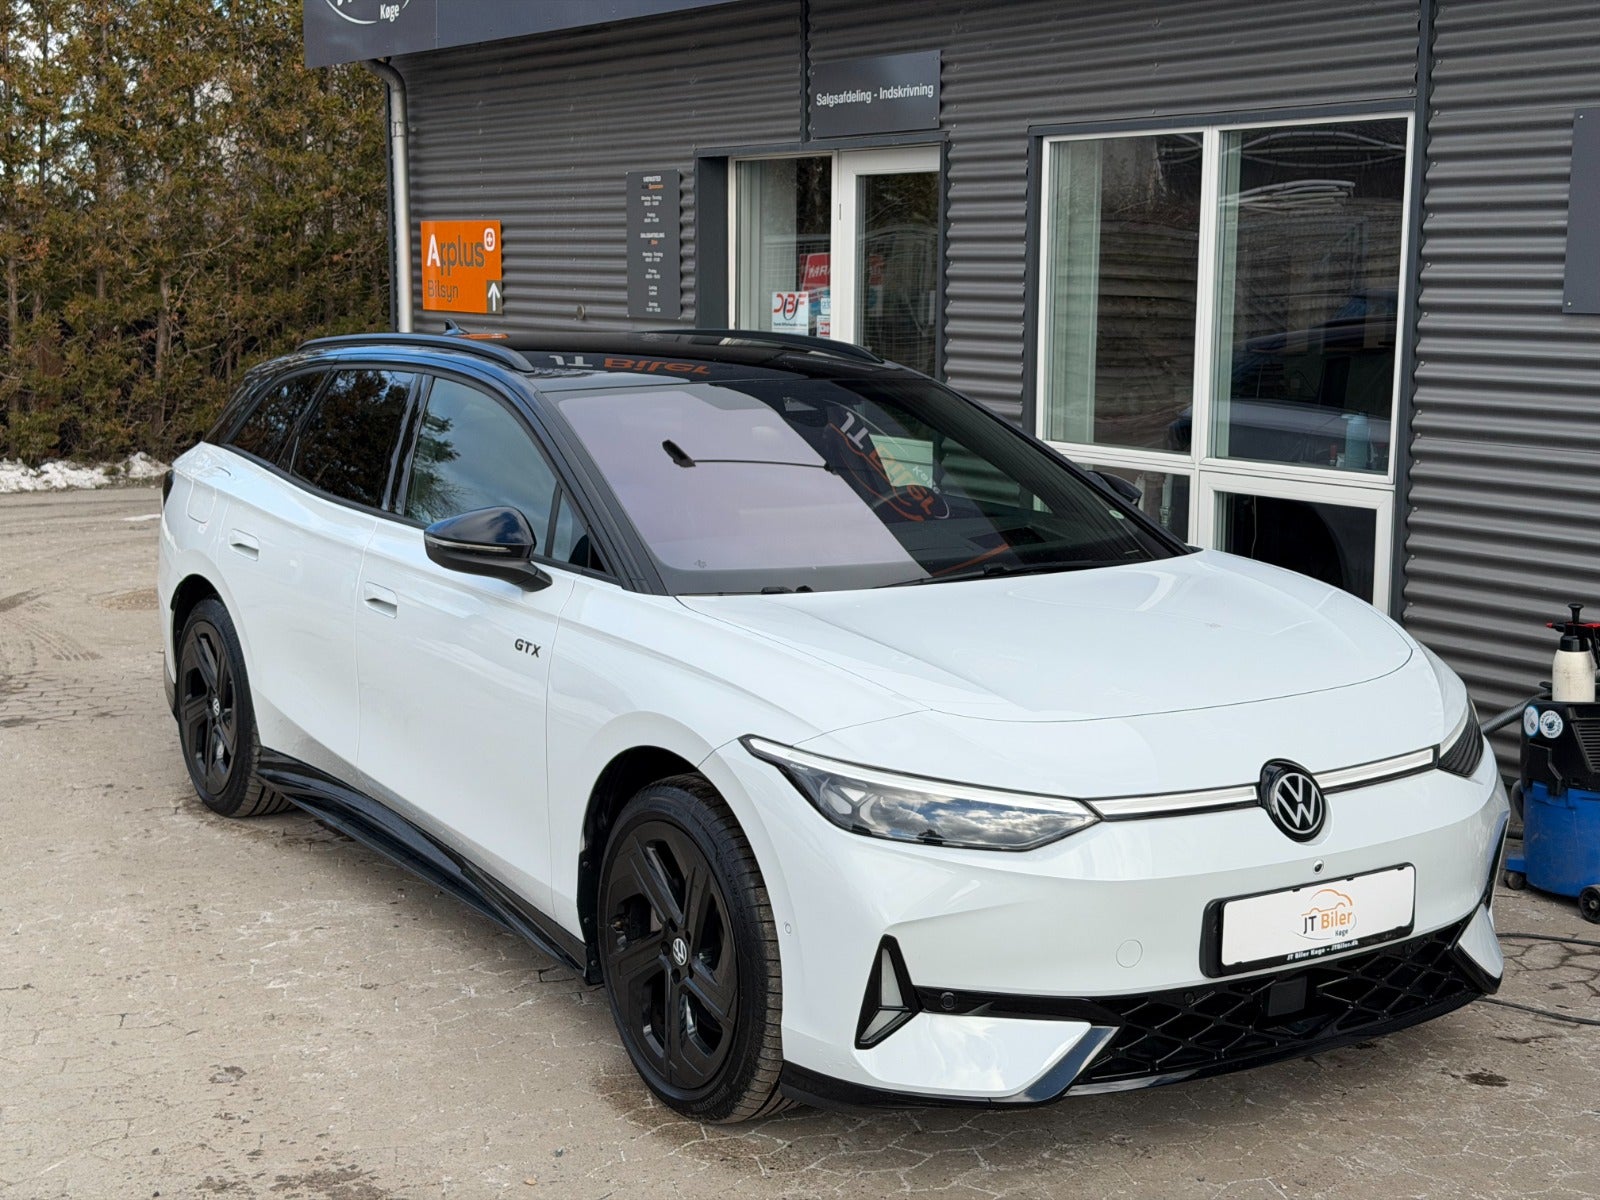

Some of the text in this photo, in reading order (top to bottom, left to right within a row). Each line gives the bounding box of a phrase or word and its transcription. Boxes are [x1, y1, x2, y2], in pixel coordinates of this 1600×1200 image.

[380, 4, 400, 22] Køge
[816, 90, 872, 107] Salgsafdeling
[880, 83, 934, 100] Indskrivning
[427, 280, 459, 303] Bilsyn
[514, 638, 542, 658] GTX
[1303, 911, 1353, 934] JT Biler
[1294, 951, 1310, 960] Biler
